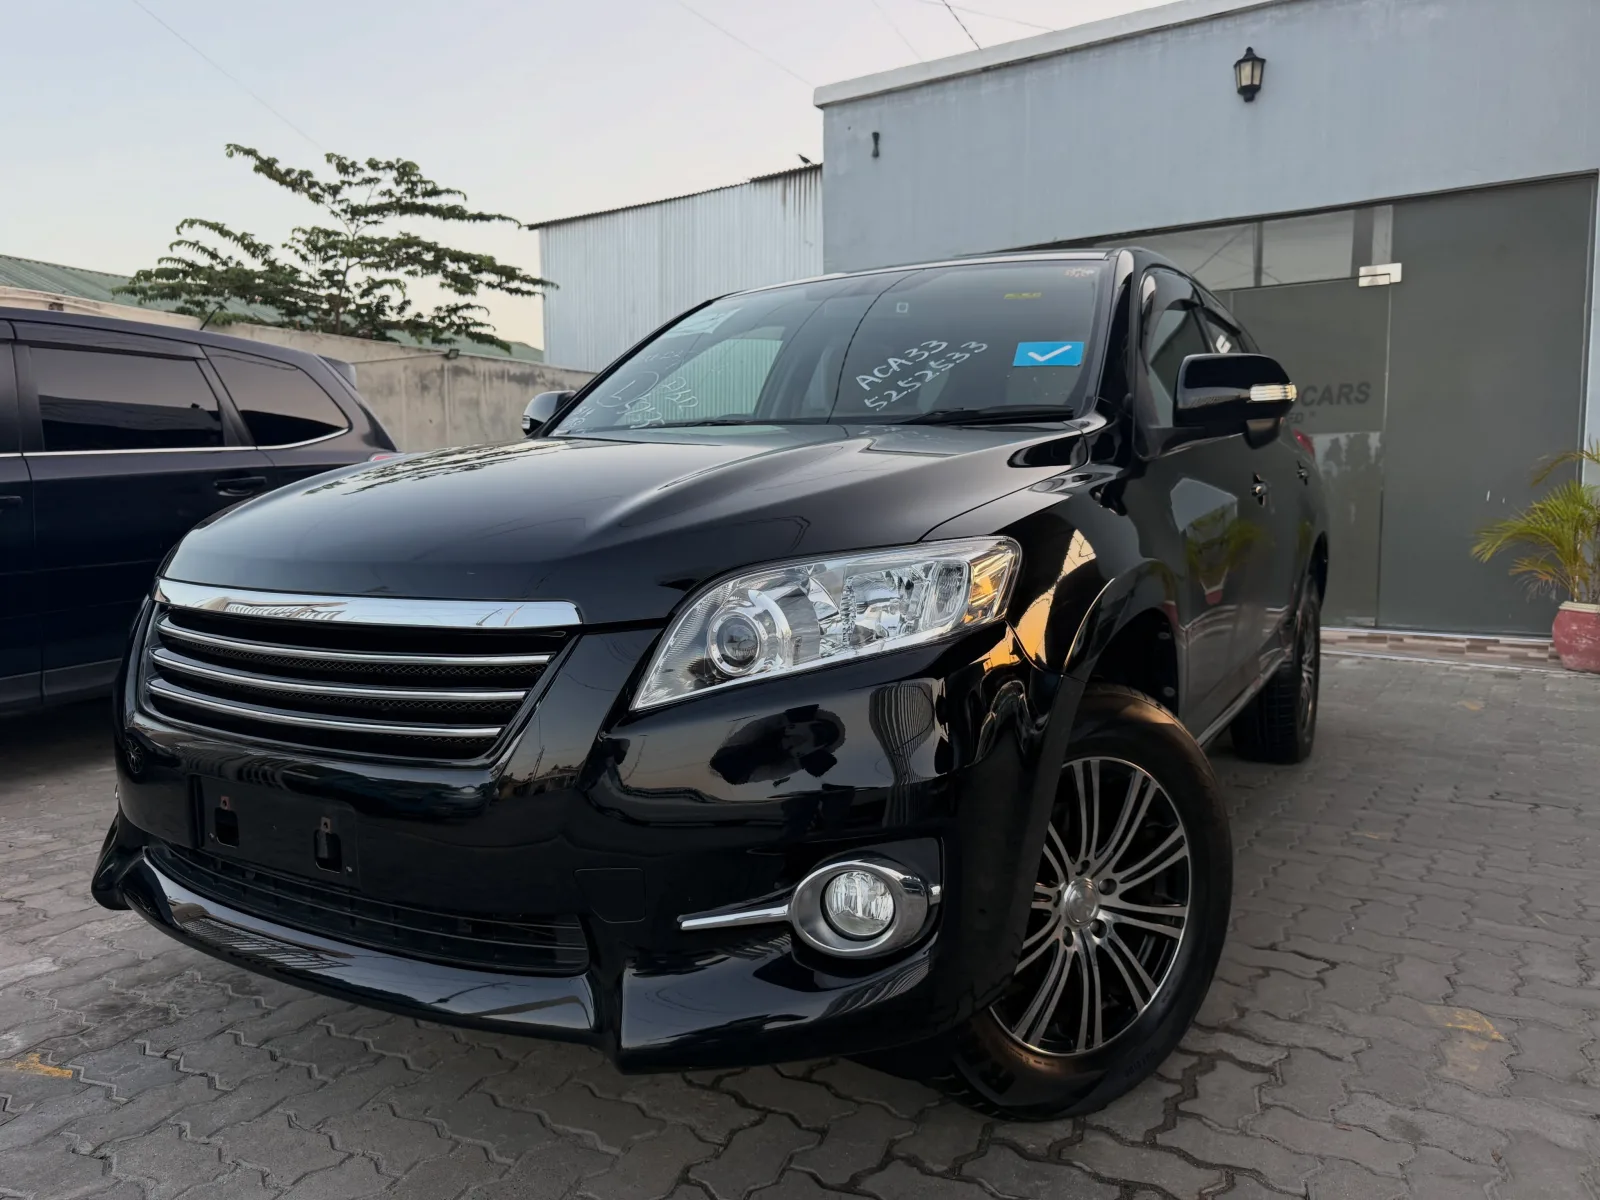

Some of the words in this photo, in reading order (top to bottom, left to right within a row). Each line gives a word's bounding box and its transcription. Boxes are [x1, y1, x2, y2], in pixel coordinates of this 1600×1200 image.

[855, 340, 948, 391] ACA33
[864, 341, 988, 411] 5252533
[1301, 381, 1372, 407] CARS
